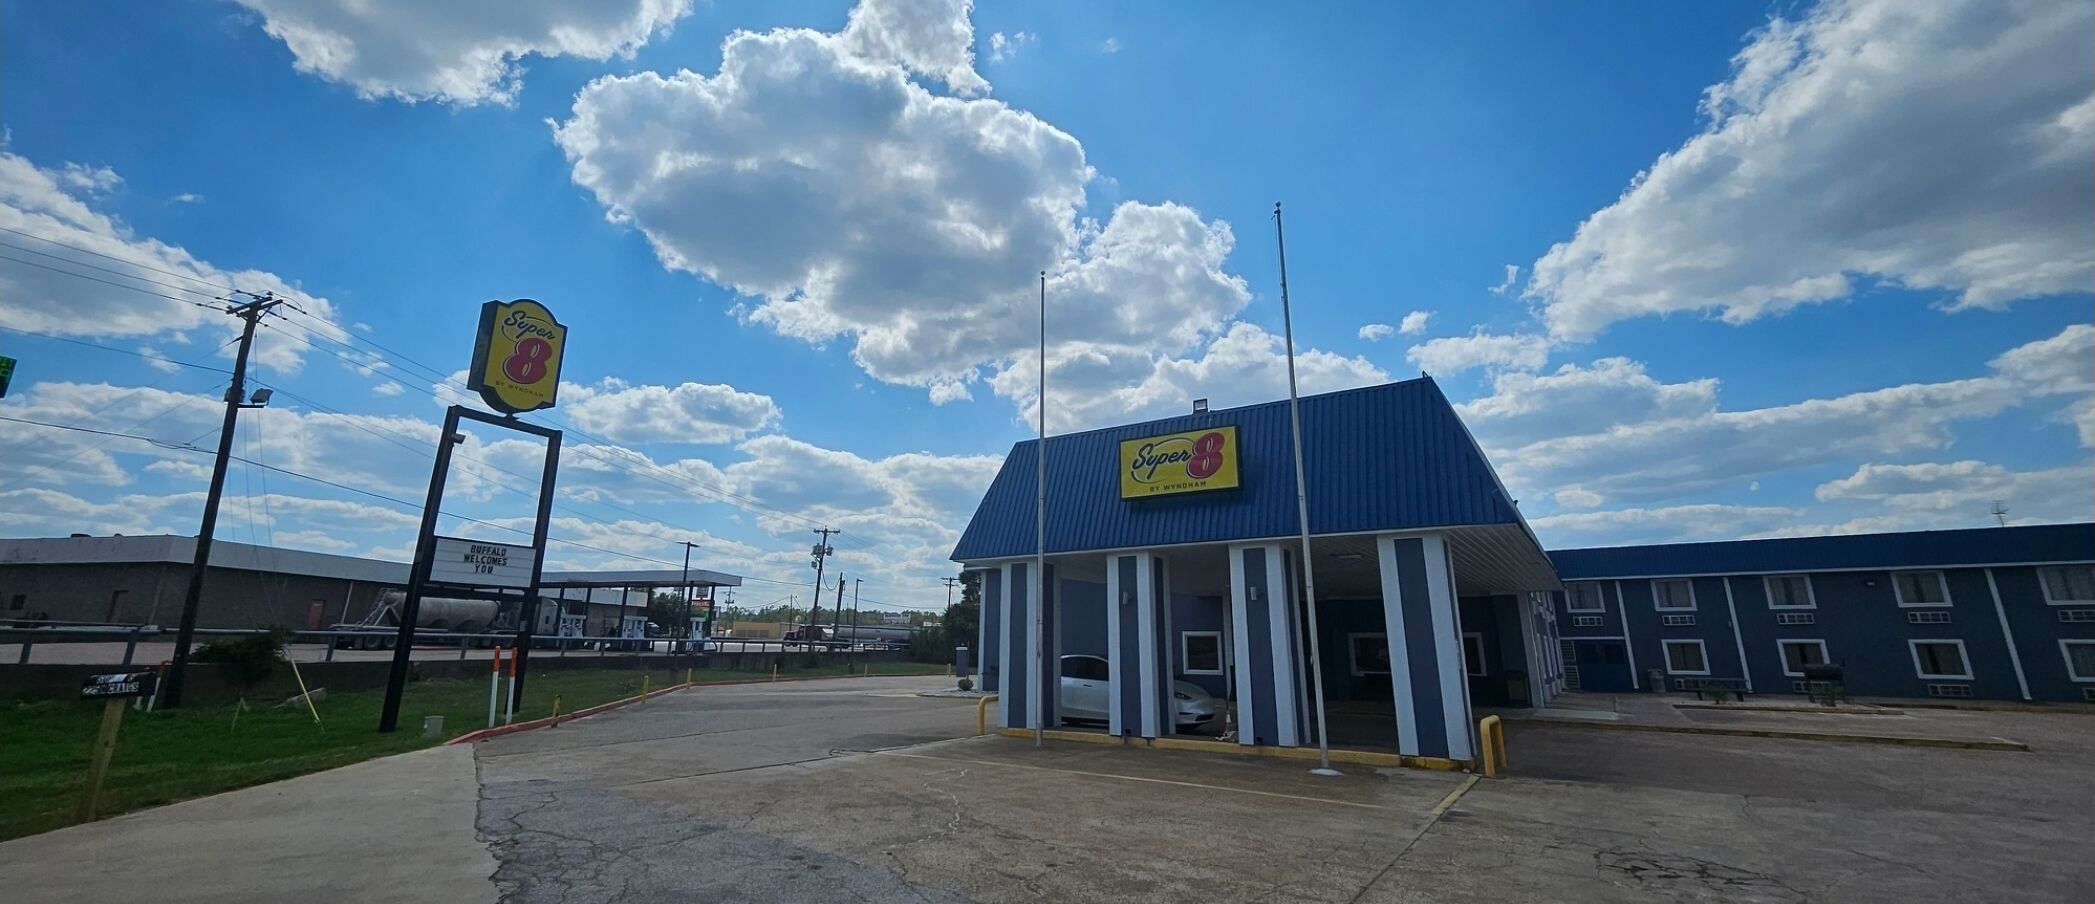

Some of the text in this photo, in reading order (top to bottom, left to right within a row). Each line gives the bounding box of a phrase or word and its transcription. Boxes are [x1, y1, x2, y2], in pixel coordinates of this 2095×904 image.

[503, 310, 555, 339] Super
[503, 338, 552, 384] 8
[1132, 432, 1225, 480] Super 8
[1164, 481, 1207, 491] WYNDHAM
[470, 544, 507, 557] BUFFALO
[463, 553, 507, 567] WELCOMES
[475, 564, 494, 574] YOU
